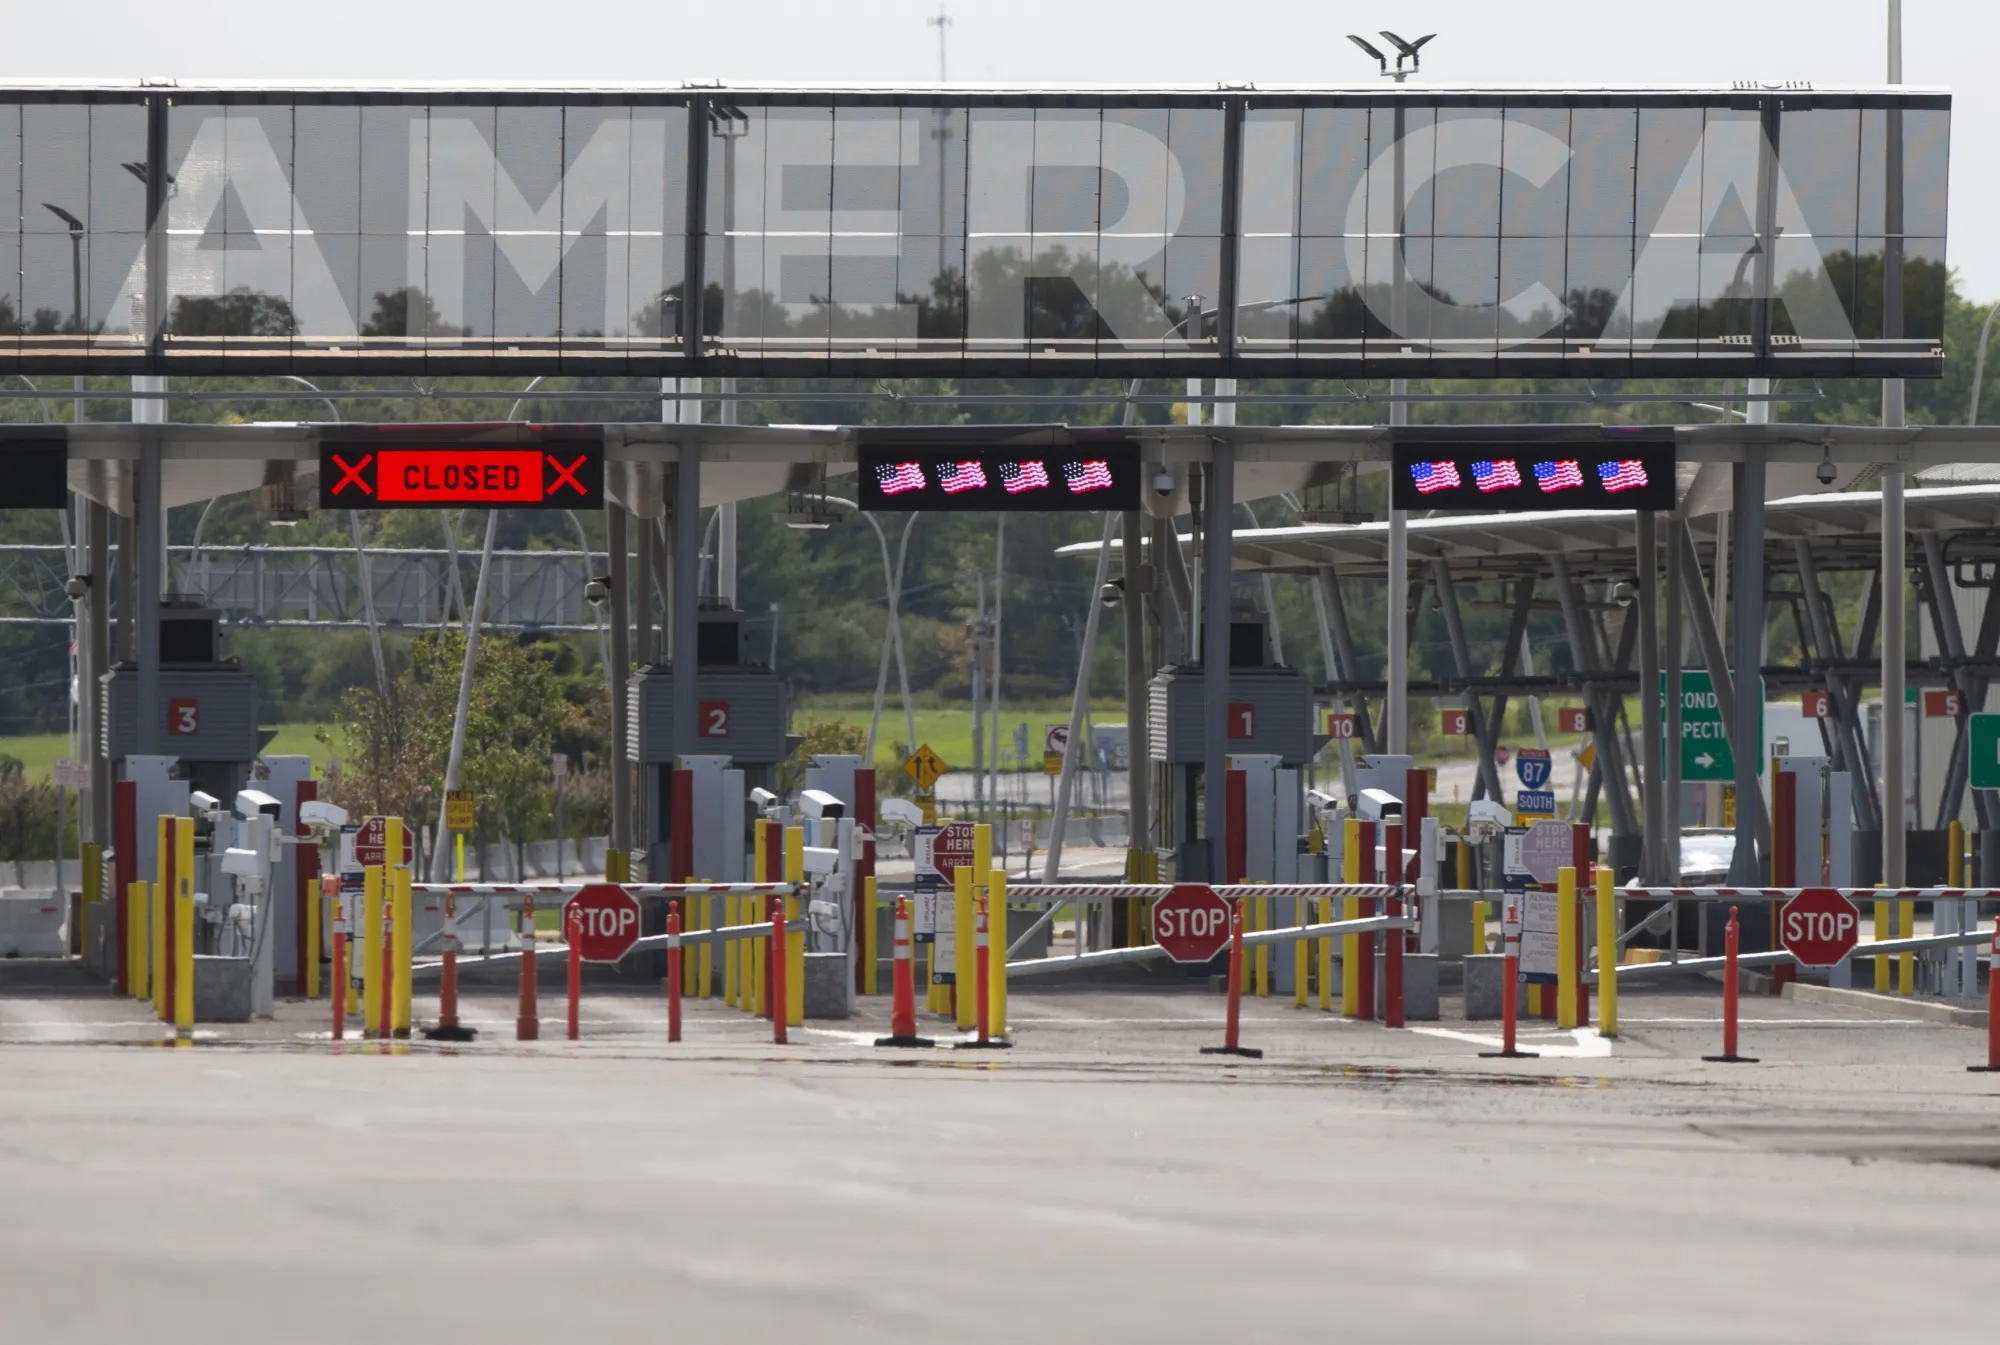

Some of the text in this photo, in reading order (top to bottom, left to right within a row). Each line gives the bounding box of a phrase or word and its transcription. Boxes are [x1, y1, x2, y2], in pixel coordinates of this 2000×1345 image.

[93, 114, 1862, 351] AMERICA
[403, 464, 530, 491] CLOSED
[1816, 698, 1827, 717] 6
[1945, 695, 1958, 715] 5
[178, 706, 197, 733] 3
[708, 709, 727, 735] 2
[1241, 711, 1252, 736] 1
[1333, 719, 1353, 737] 10
[1455, 716, 1466, 734] 9
[1574, 713, 1585, 731] 8
[1523, 762, 1544, 782] 87
[1519, 794, 1553, 809] SOUTH
[1536, 825, 1568, 836] STOP
[1536, 837, 1568, 849] HERE
[1159, 908, 1225, 937] STOP
[1786, 911, 1854, 942] STOP
